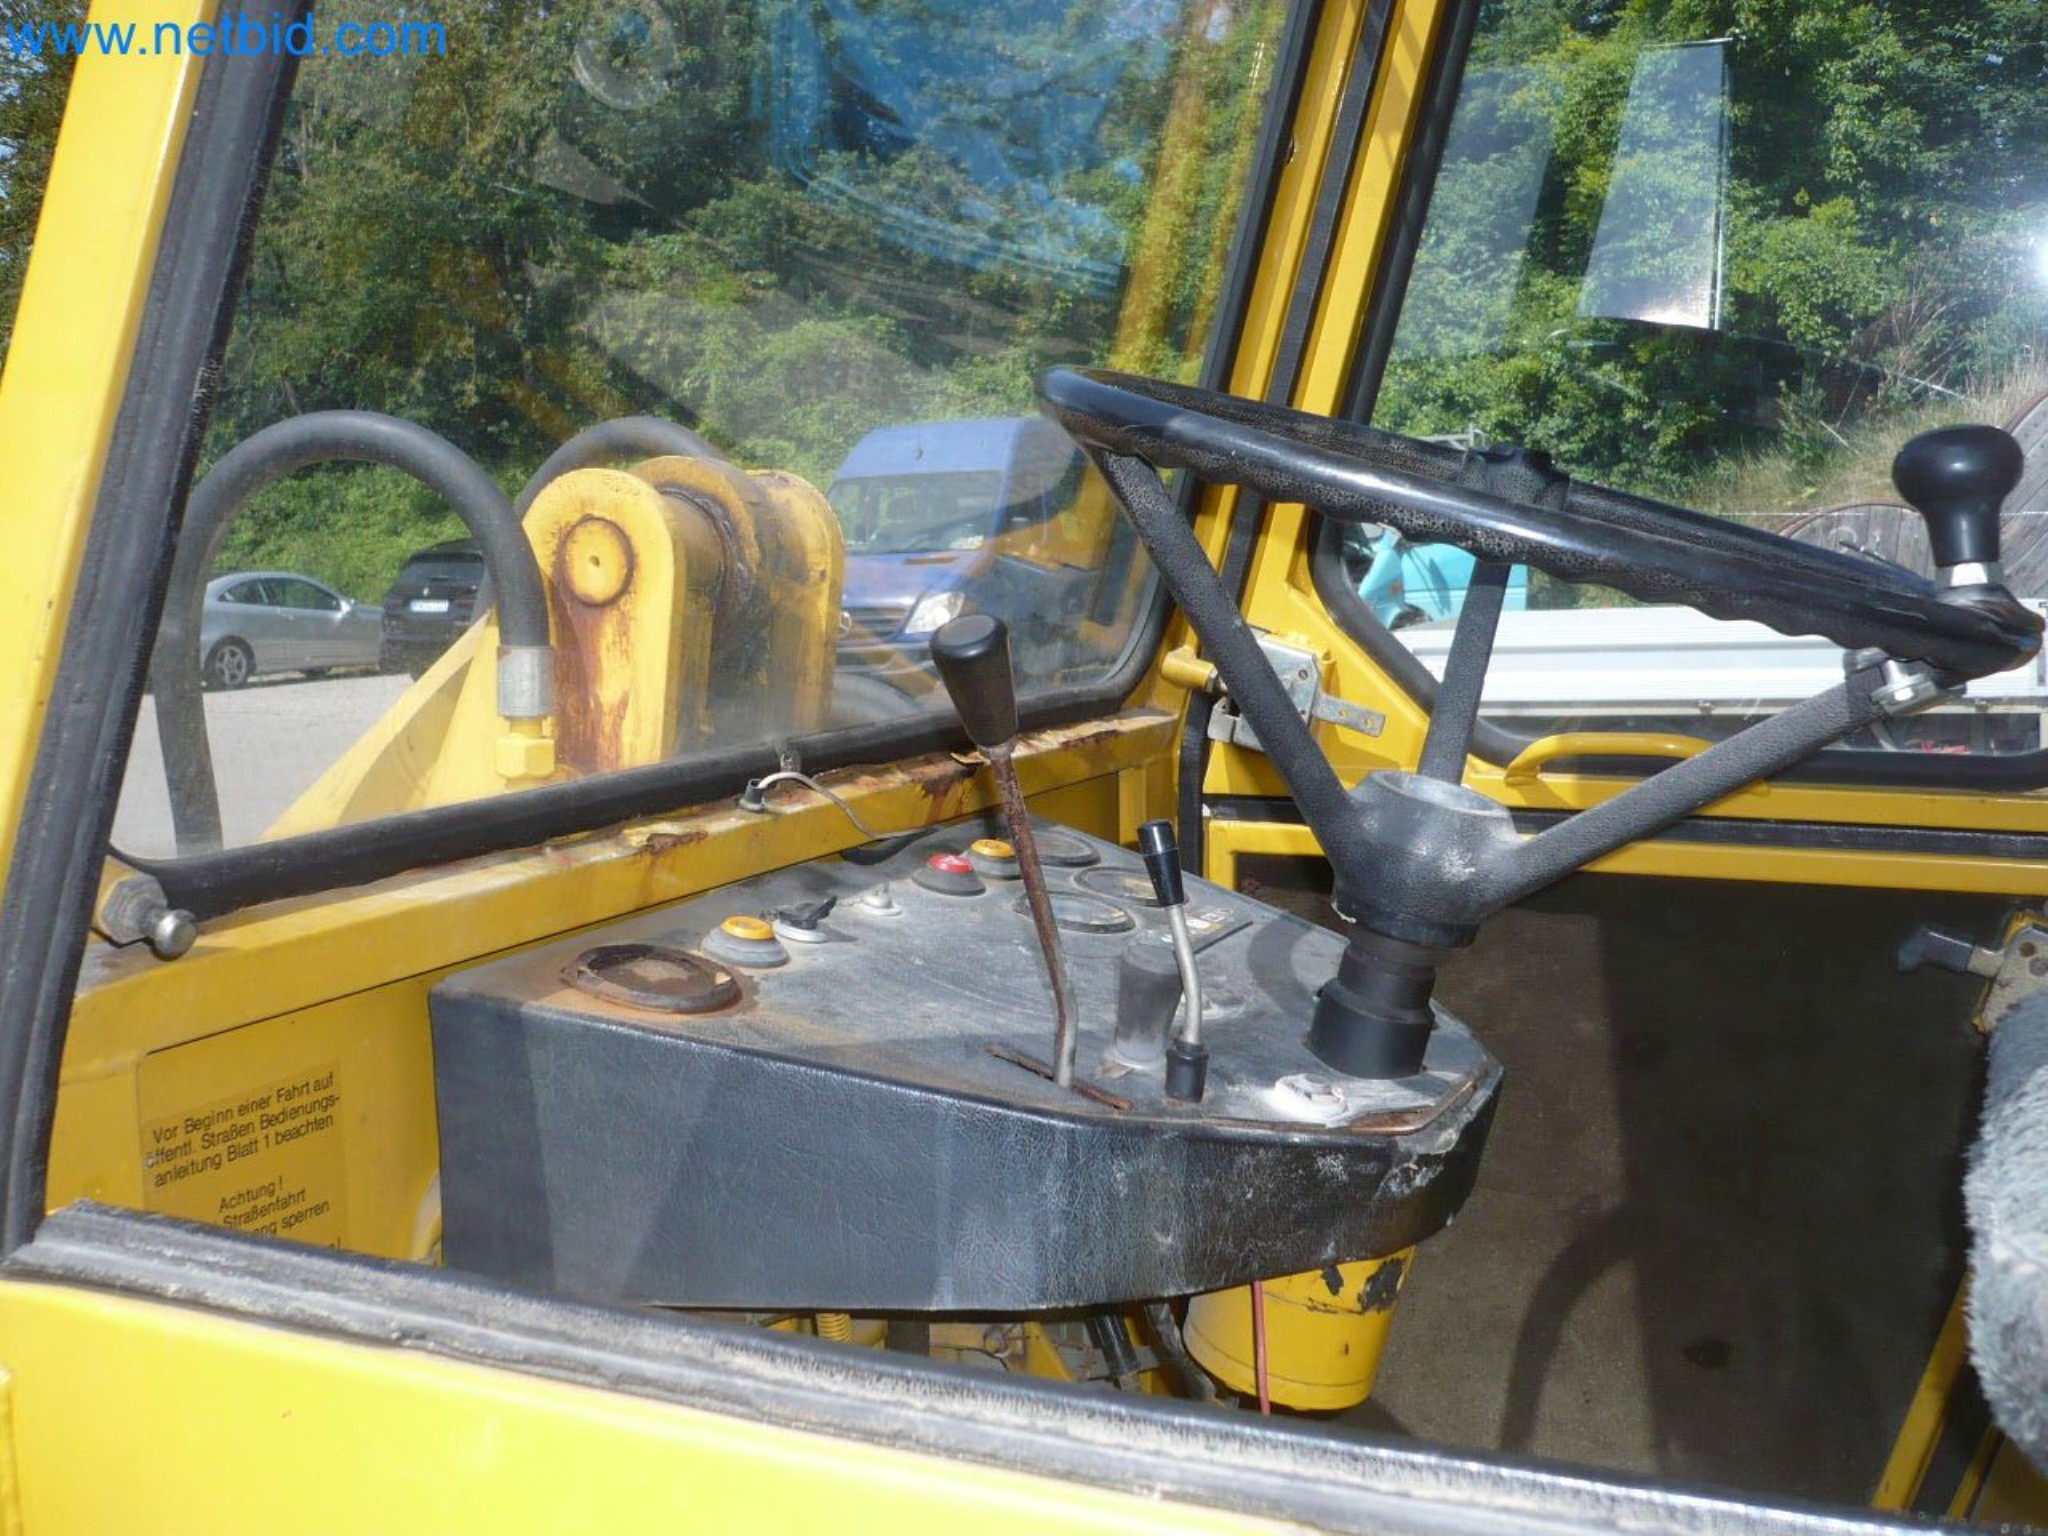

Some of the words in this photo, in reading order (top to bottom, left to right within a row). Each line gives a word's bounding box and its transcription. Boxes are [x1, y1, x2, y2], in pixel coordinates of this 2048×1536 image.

[153, 1125, 179, 1144] Vor
[184, 1107, 234, 1132] Beginn
[237, 1094, 273, 1115] einer
[276, 1079, 310, 1103] Fahrt
[312, 1070, 334, 1092] auf
[200, 1120, 255, 1149] Straßen
[259, 1094, 341, 1130] Bedienungs-
[153, 1152, 222, 1188] anleitung
[227, 1138, 259, 1163] Blatt
[275, 1113, 334, 1146] beachten
[218, 1180, 276, 1213] Achtung
[281, 1199, 330, 1229] sperren
